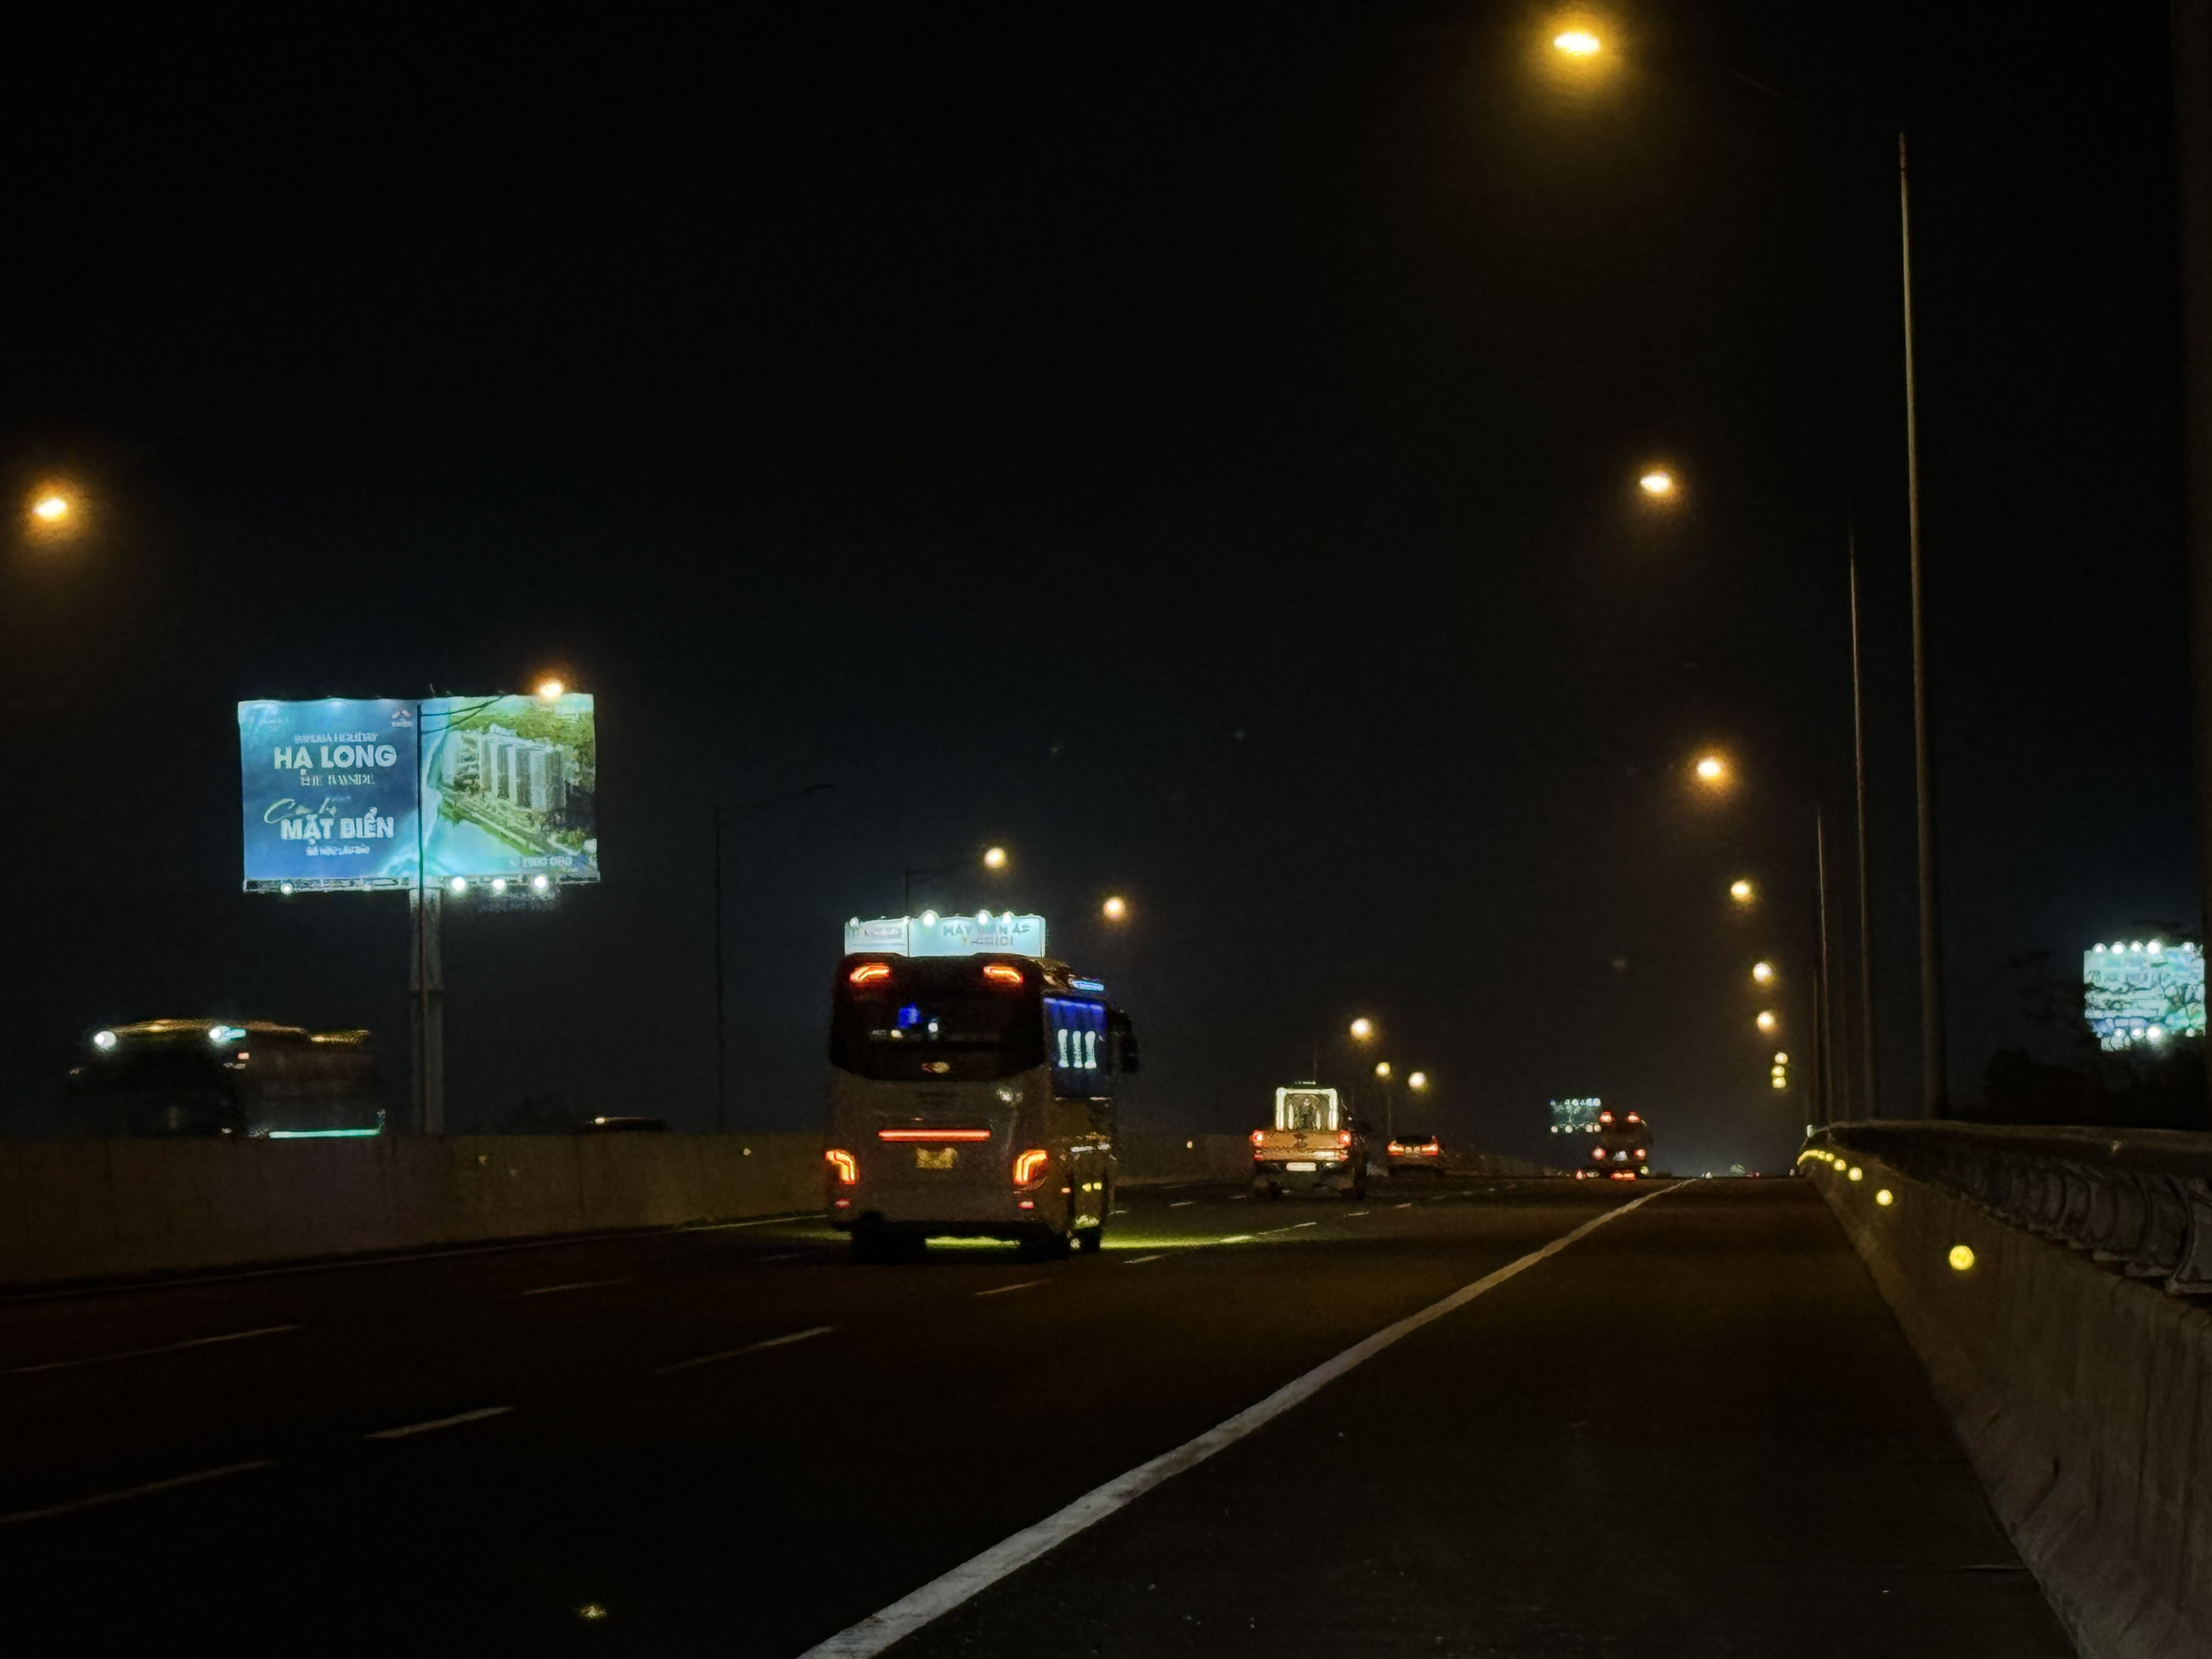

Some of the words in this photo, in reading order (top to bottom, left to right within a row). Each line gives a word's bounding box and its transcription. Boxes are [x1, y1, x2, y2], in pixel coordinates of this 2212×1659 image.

[274, 746, 313, 776] HẠ
[320, 744, 397, 768] LONG
[280, 814, 334, 845] MẶT
